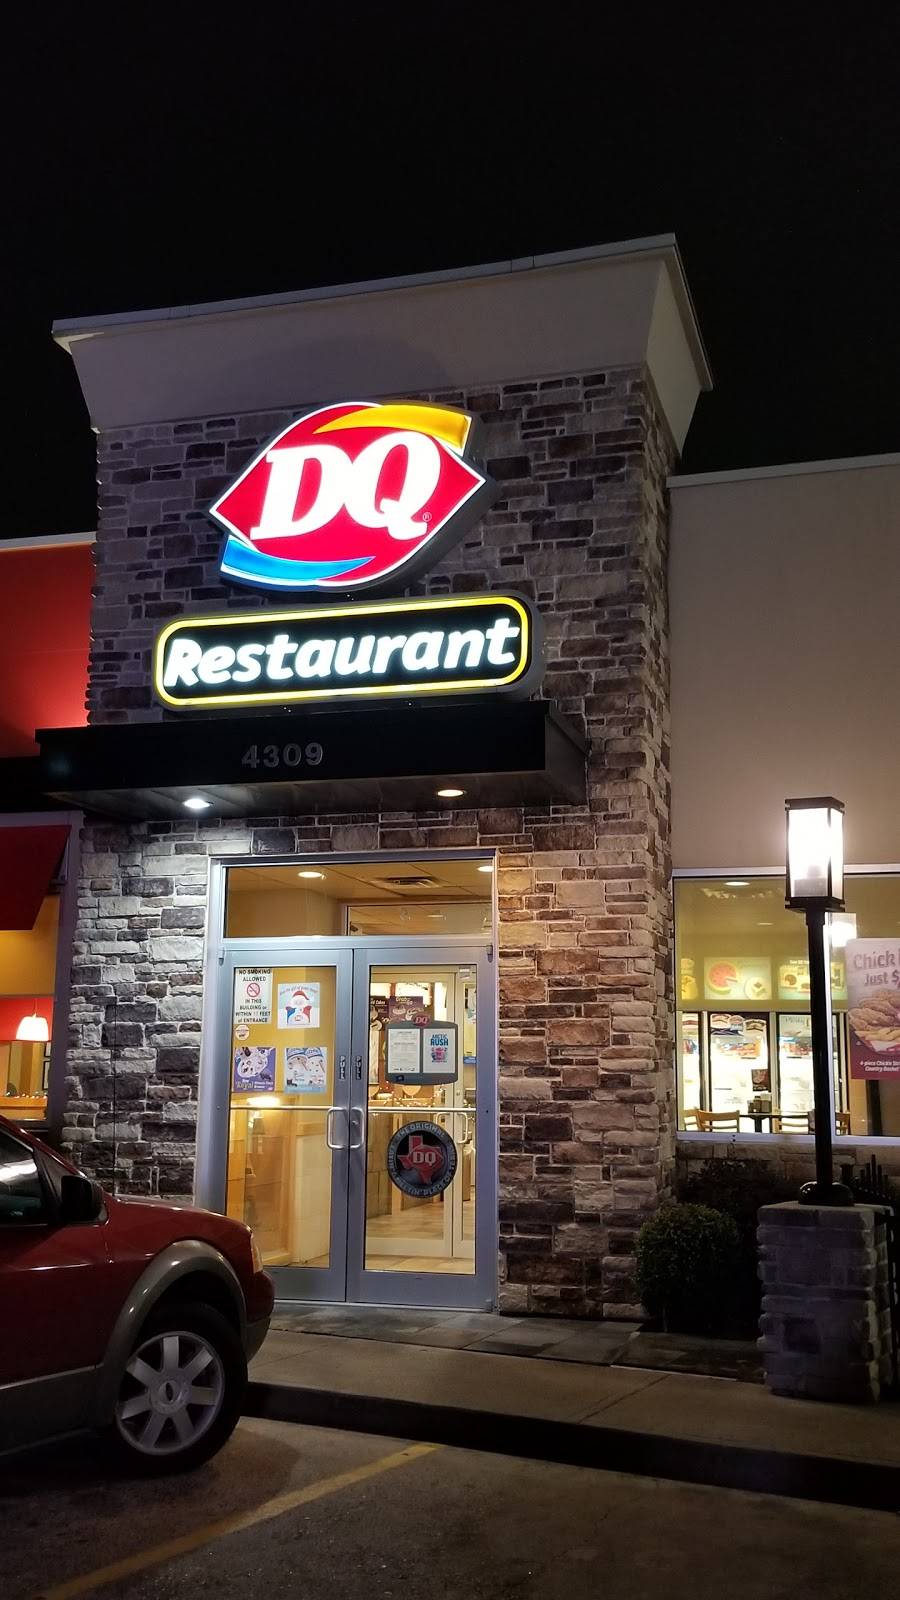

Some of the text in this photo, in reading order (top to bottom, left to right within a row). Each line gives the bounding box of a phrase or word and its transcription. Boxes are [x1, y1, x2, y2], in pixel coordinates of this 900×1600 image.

[250, 432, 440, 540] DQ
[164, 618, 520, 687] Restaurant
[241, 742, 323, 768] 4309
[854, 951, 895, 969] Chick
[864, 972, 888, 986] Just
[413, 1151, 436, 1167] DQ
